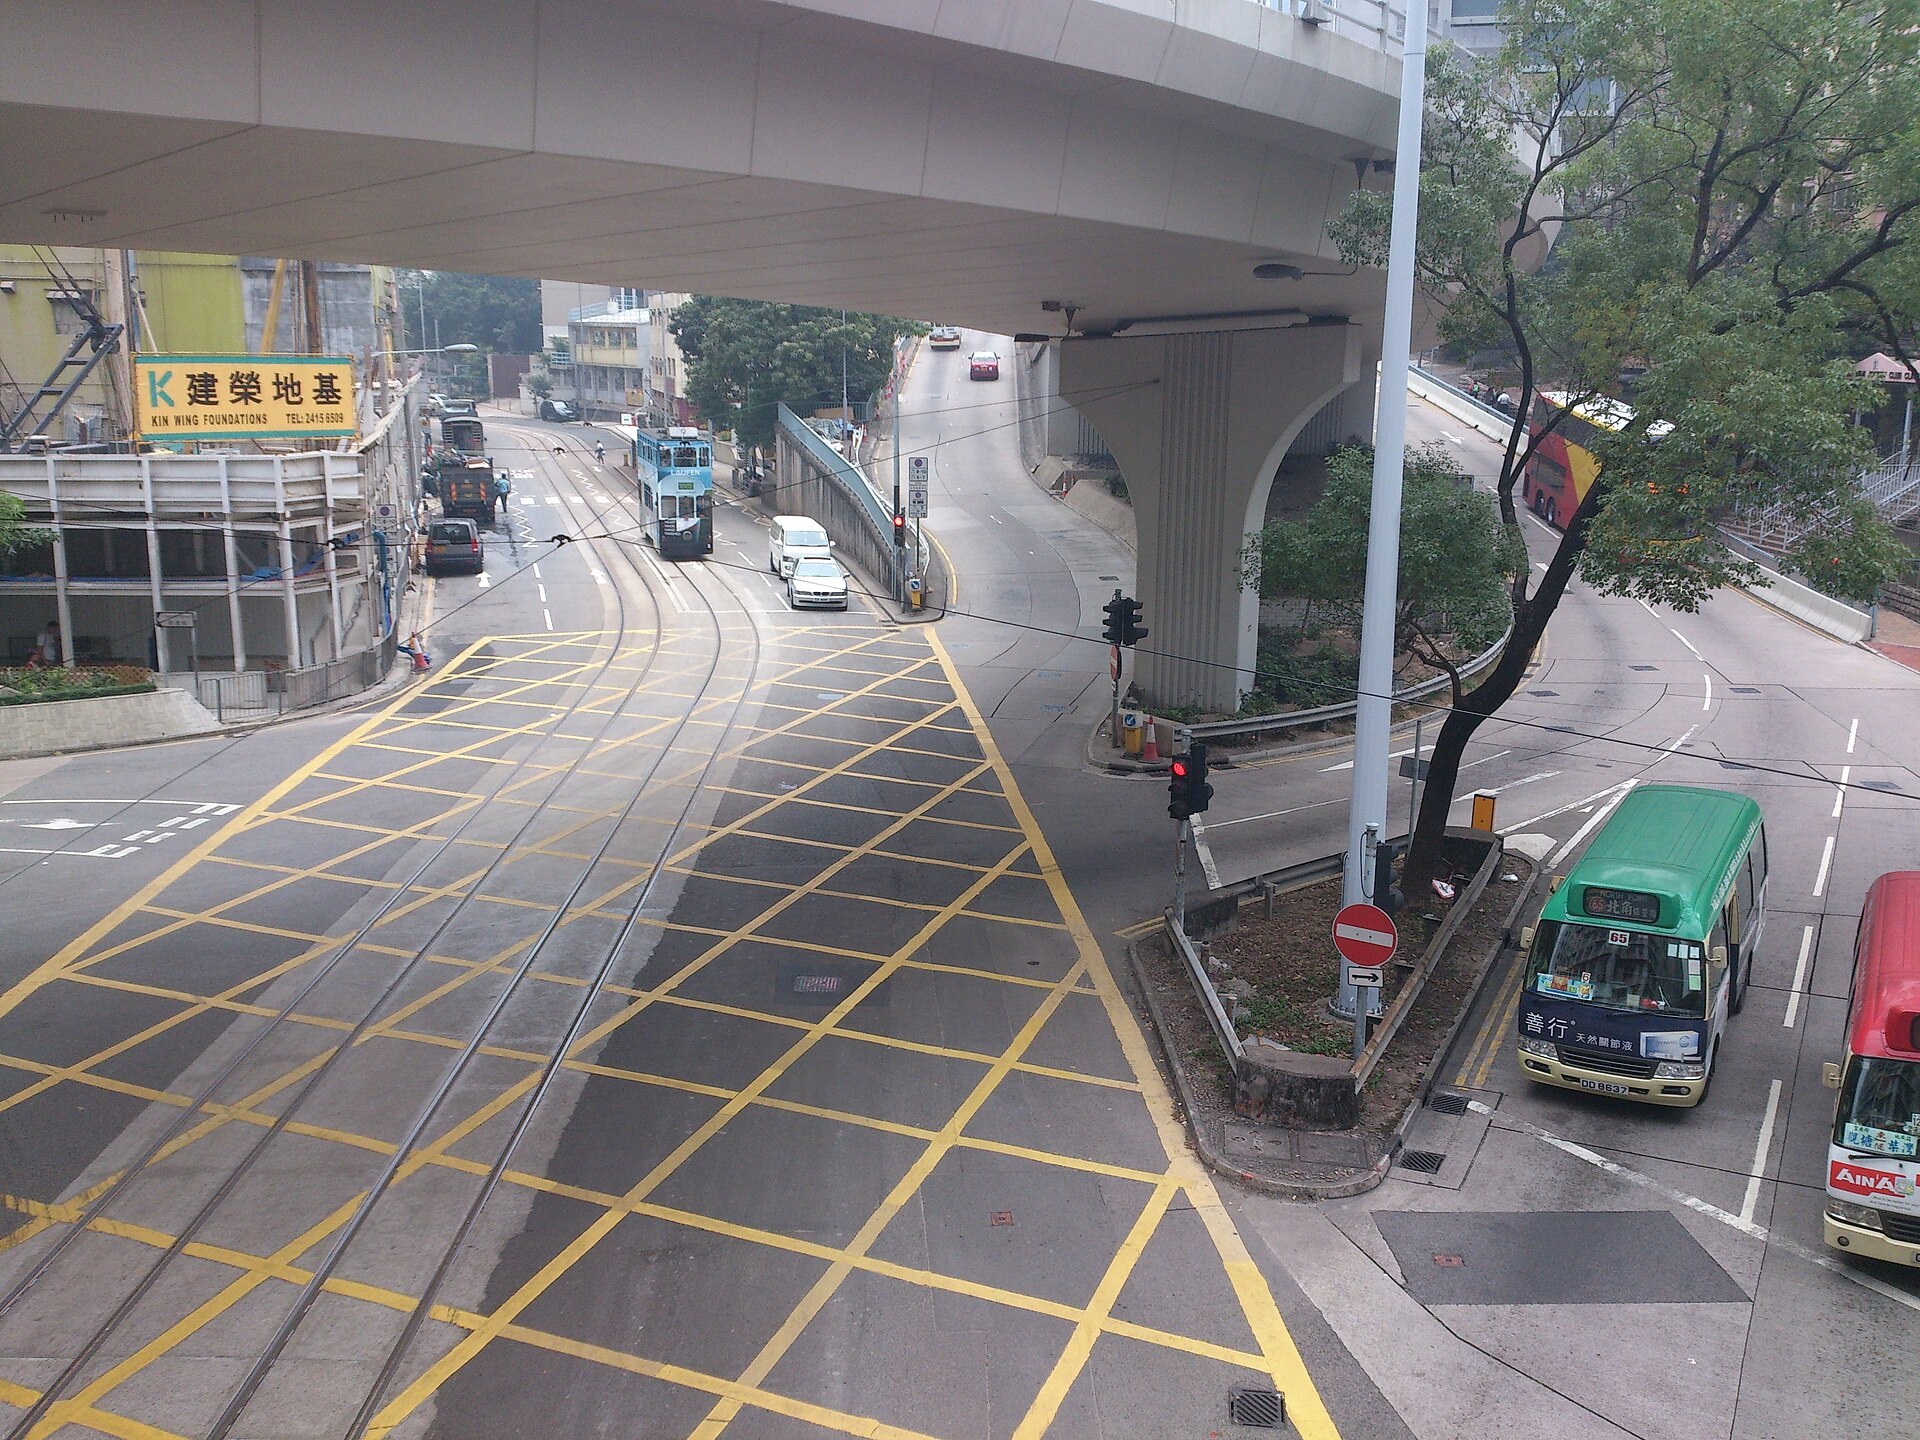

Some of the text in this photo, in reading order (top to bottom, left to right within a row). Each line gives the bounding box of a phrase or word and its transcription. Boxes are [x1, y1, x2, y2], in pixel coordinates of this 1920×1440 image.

[148, 370, 175, 407] K
[186, 370, 343, 406] 建榮地基
[151, 412, 344, 427] KIN WING FOUNDATIONS TEL: 2415 6509
[1600, 890, 1624, 900] NORTH
[1591, 899, 1604, 910] 65
[1610, 932, 1628, 944] 65
[1582, 973, 1590, 981] 6
[1525, 1011, 1569, 1039] 善行
[1575, 1032, 1633, 1052] 天然關節液
[1597, 1081, 1628, 1094] 8637
